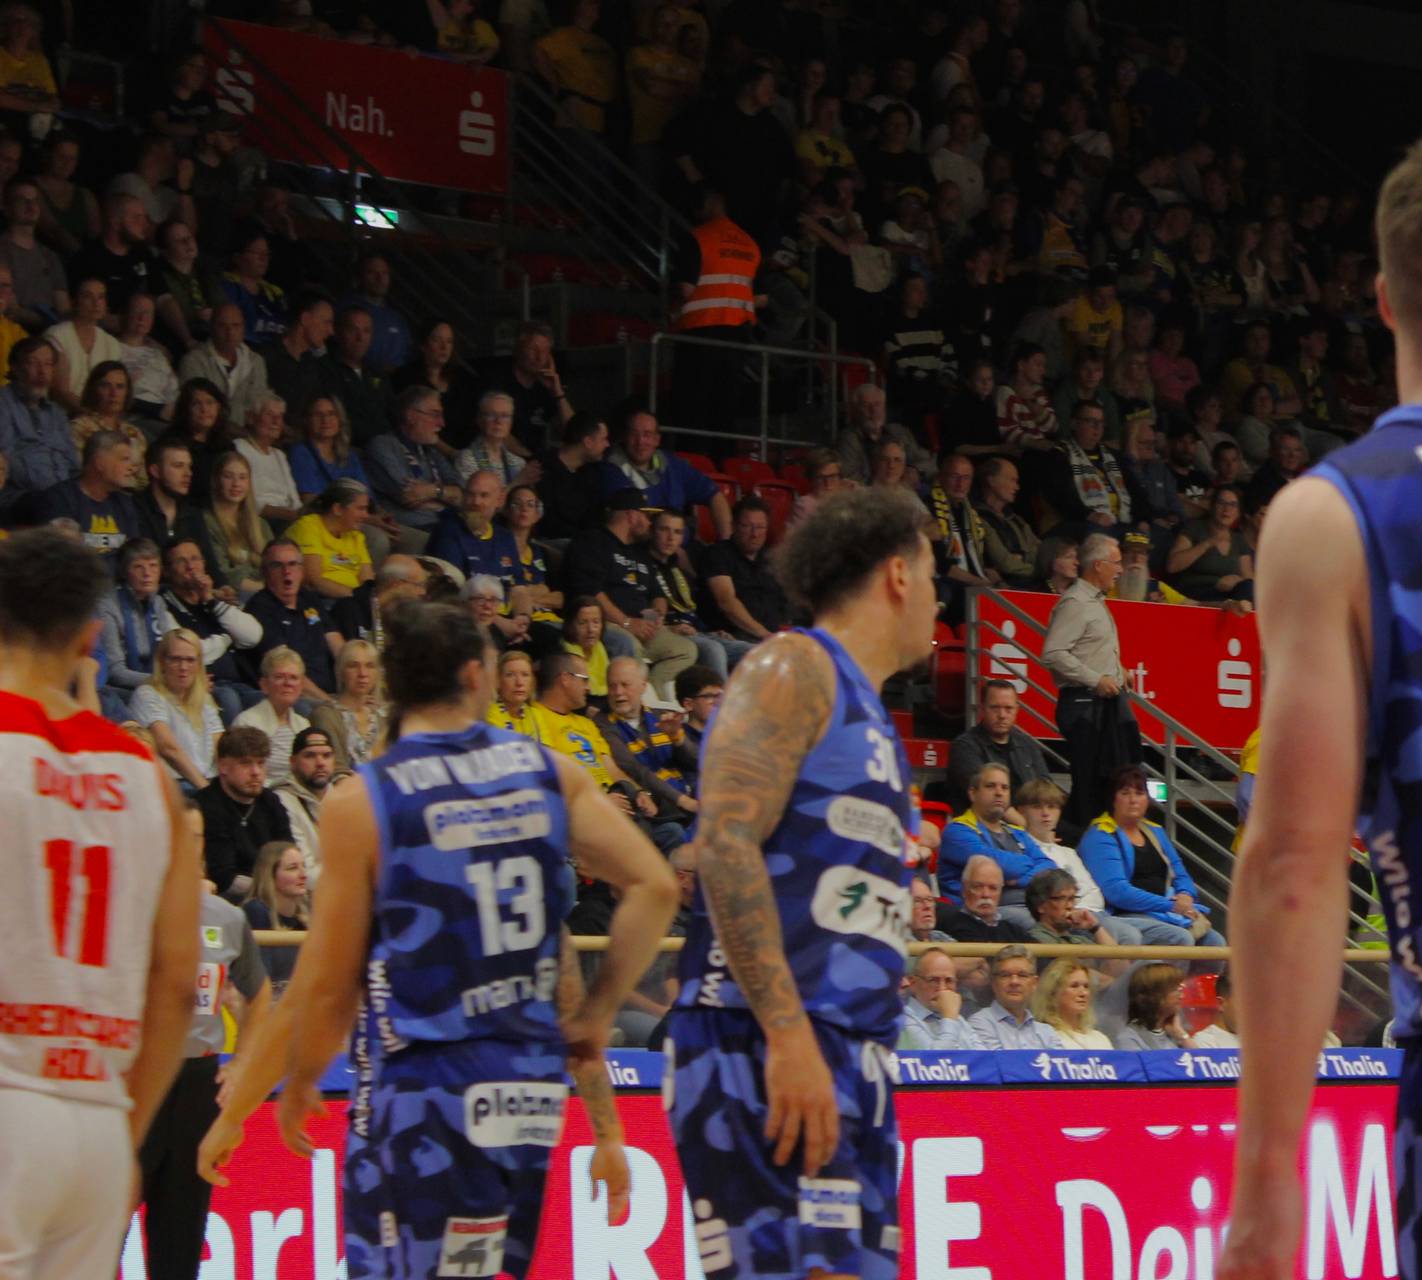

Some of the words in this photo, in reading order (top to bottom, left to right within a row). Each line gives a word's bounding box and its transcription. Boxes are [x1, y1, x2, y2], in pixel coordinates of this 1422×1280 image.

[325, 91, 395, 138] Nah.
[43, 839, 113, 968] 11
[464, 855, 546, 957] 13
[902, 1057, 970, 1082] Thalia
[1052, 1058, 1118, 1081] Thalia
[1193, 1057, 1241, 1079] Thali
[1331, 1054, 1388, 1078] Thalia
[1055, 1175, 1228, 1280] Dei
